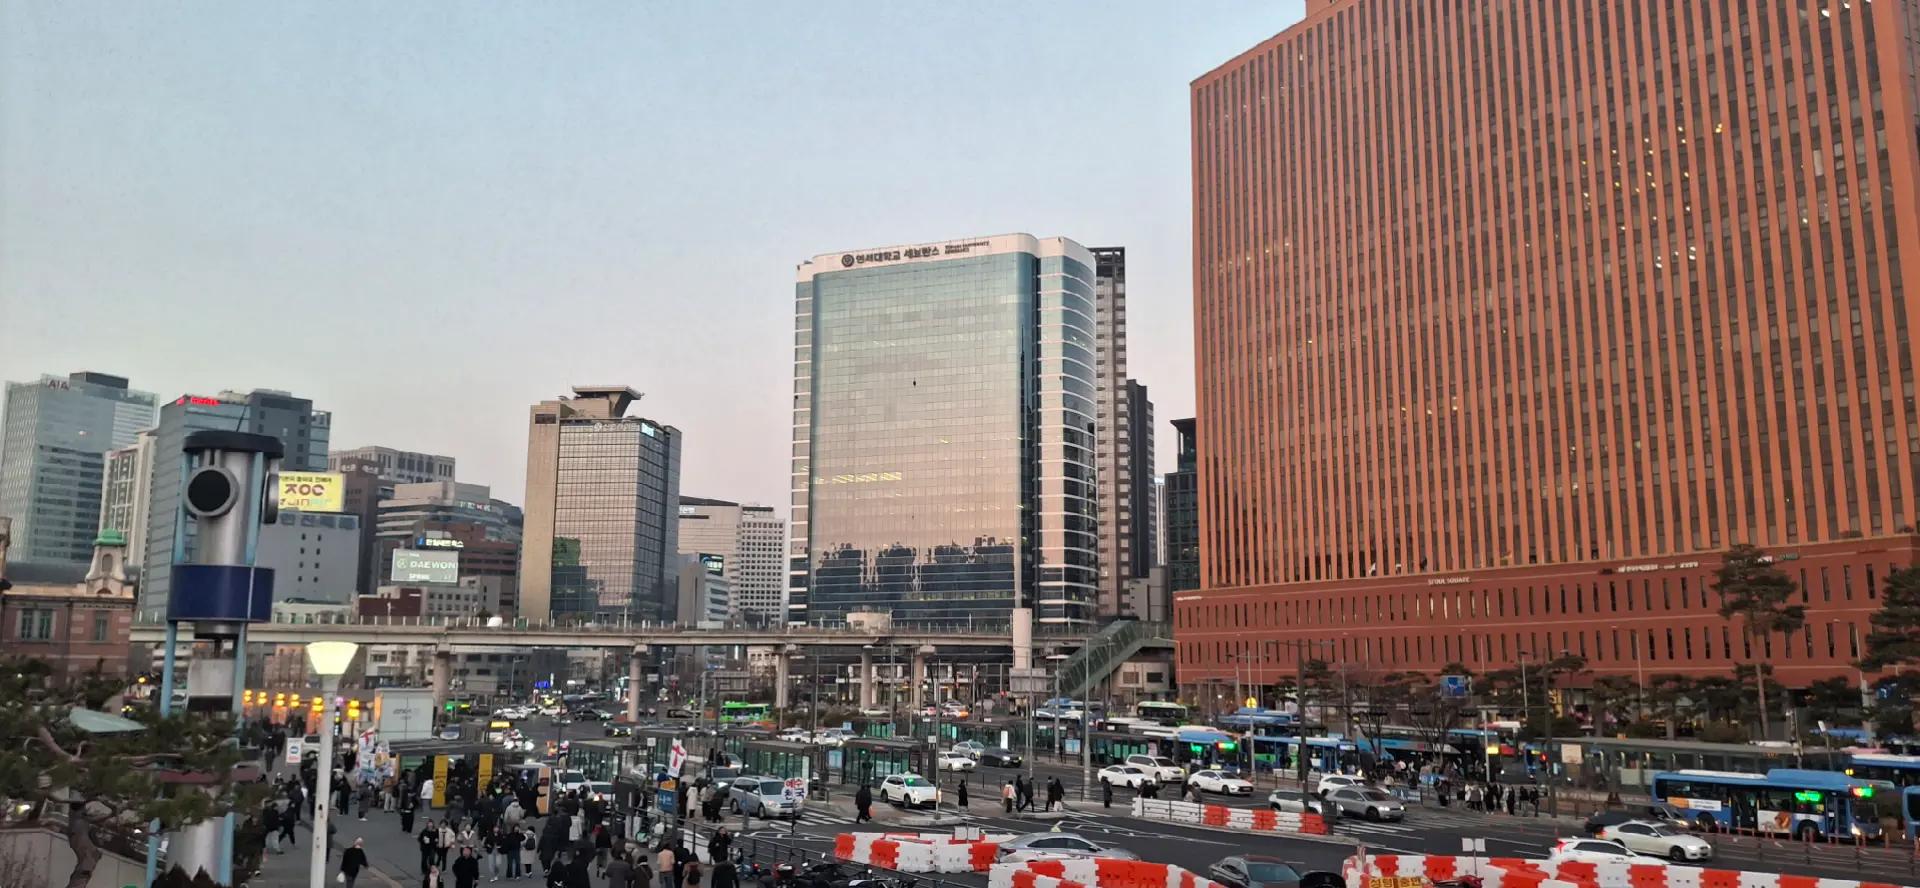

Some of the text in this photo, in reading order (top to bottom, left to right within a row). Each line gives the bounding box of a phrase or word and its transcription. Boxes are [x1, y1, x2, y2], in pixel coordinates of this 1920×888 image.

[856, 247, 939, 263] 연세대학교 세브란스
[48, 379, 69, 391] AIA
[410, 561, 456, 569] DAEWON
[785, 779, 803, 788] 예수
[785, 788, 804, 800] 천국
